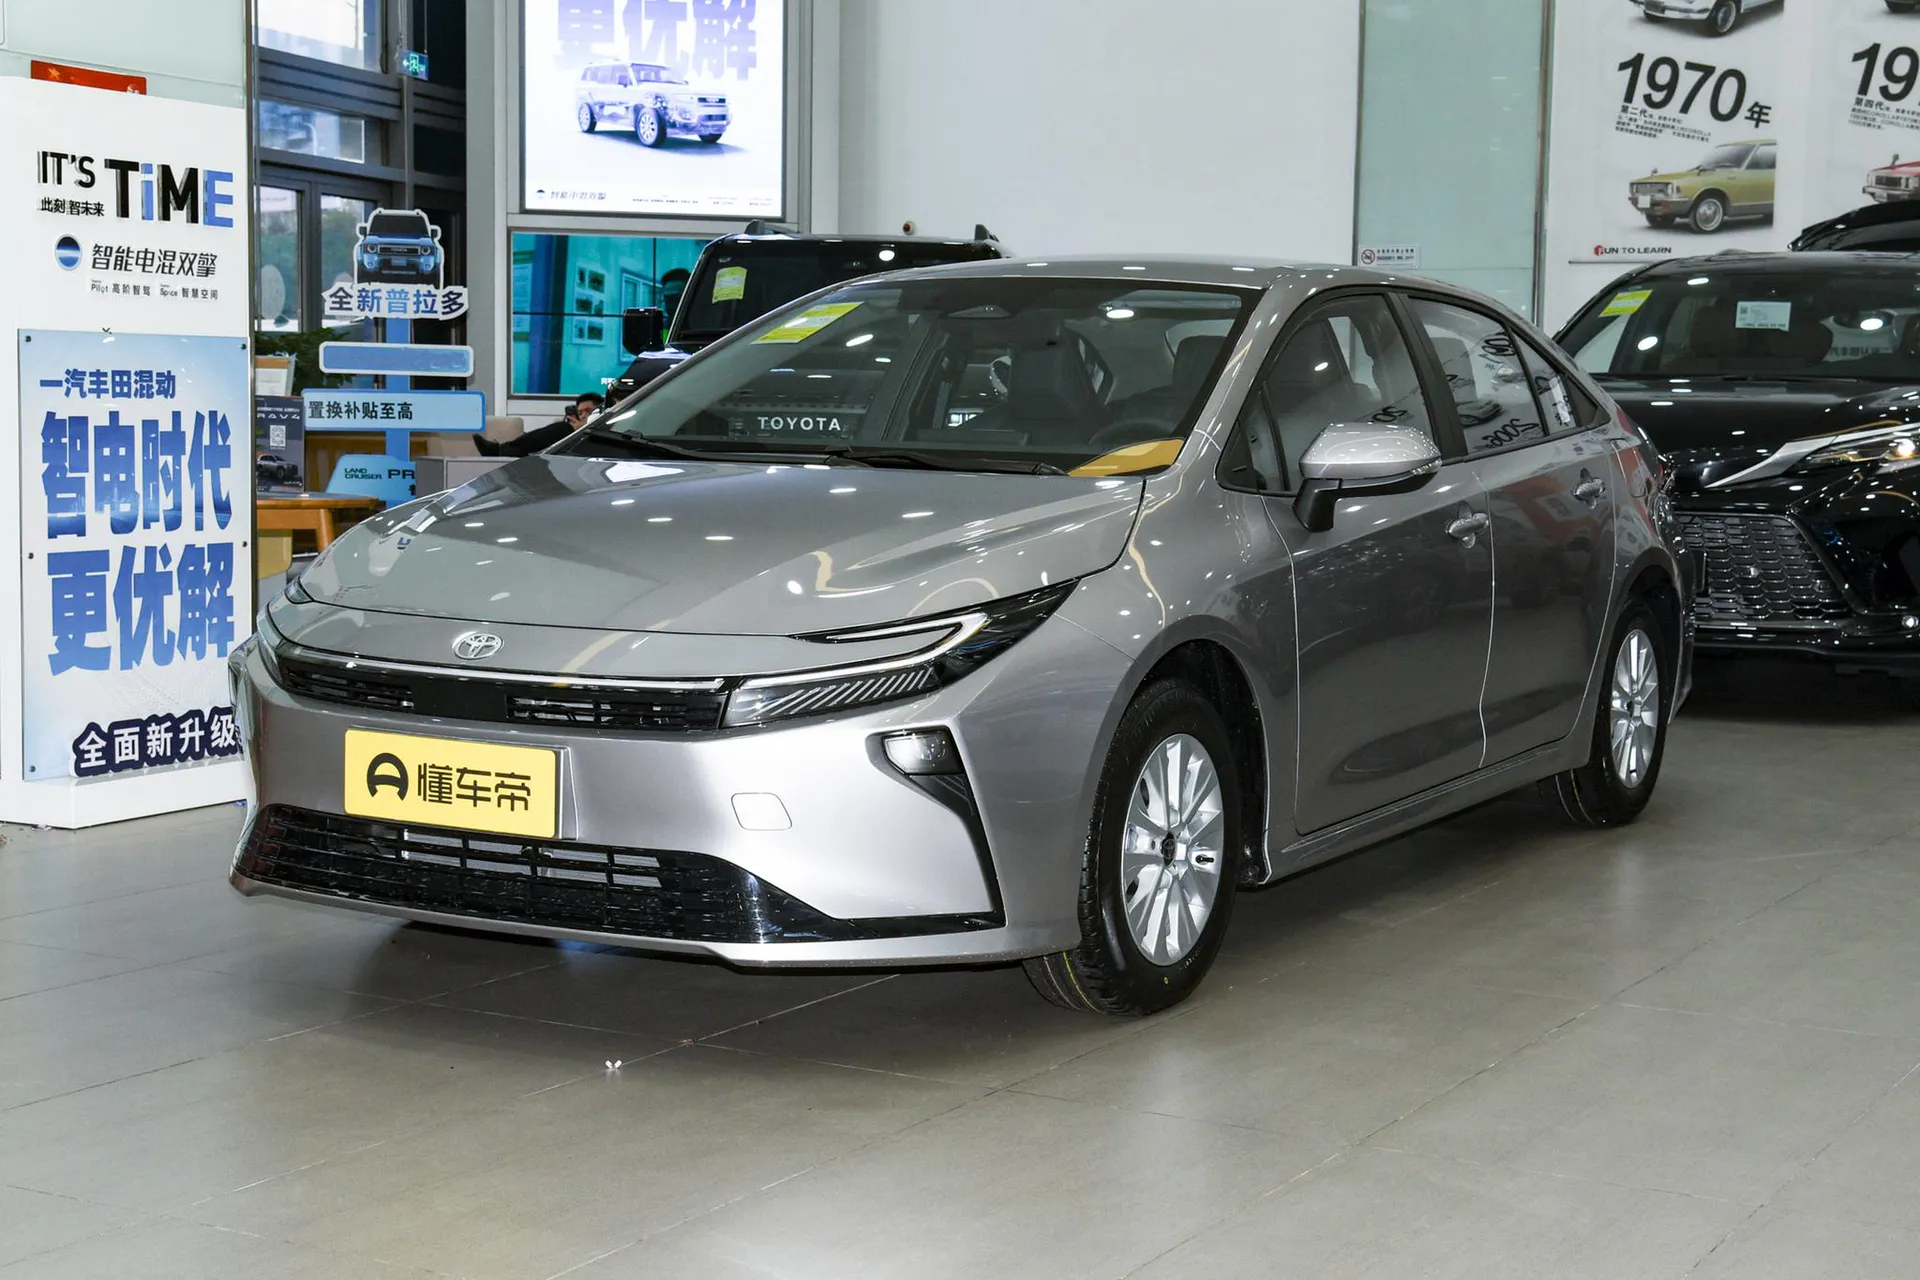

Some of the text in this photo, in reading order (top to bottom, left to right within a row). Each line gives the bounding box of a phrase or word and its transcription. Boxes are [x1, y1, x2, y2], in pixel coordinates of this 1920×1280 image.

[37, 150, 96, 189] IT'S
[40, 197, 105, 217] 此刻 智未来
[91, 243, 218, 278] 智能电混双擎
[181, 287, 218, 300] 智慧空间
[328, 286, 464, 316] 全新普拉多
[39, 368, 176, 399] 一汽丰田混动
[308, 401, 413, 421] 置换补贴至高
[757, 415, 841, 431] TOYOTA
[40, 410, 232, 539] 智电时代
[47, 542, 235, 676] 更优解
[79, 713, 236, 768] 全面新升级
[417, 762, 532, 812] 懂车帝
